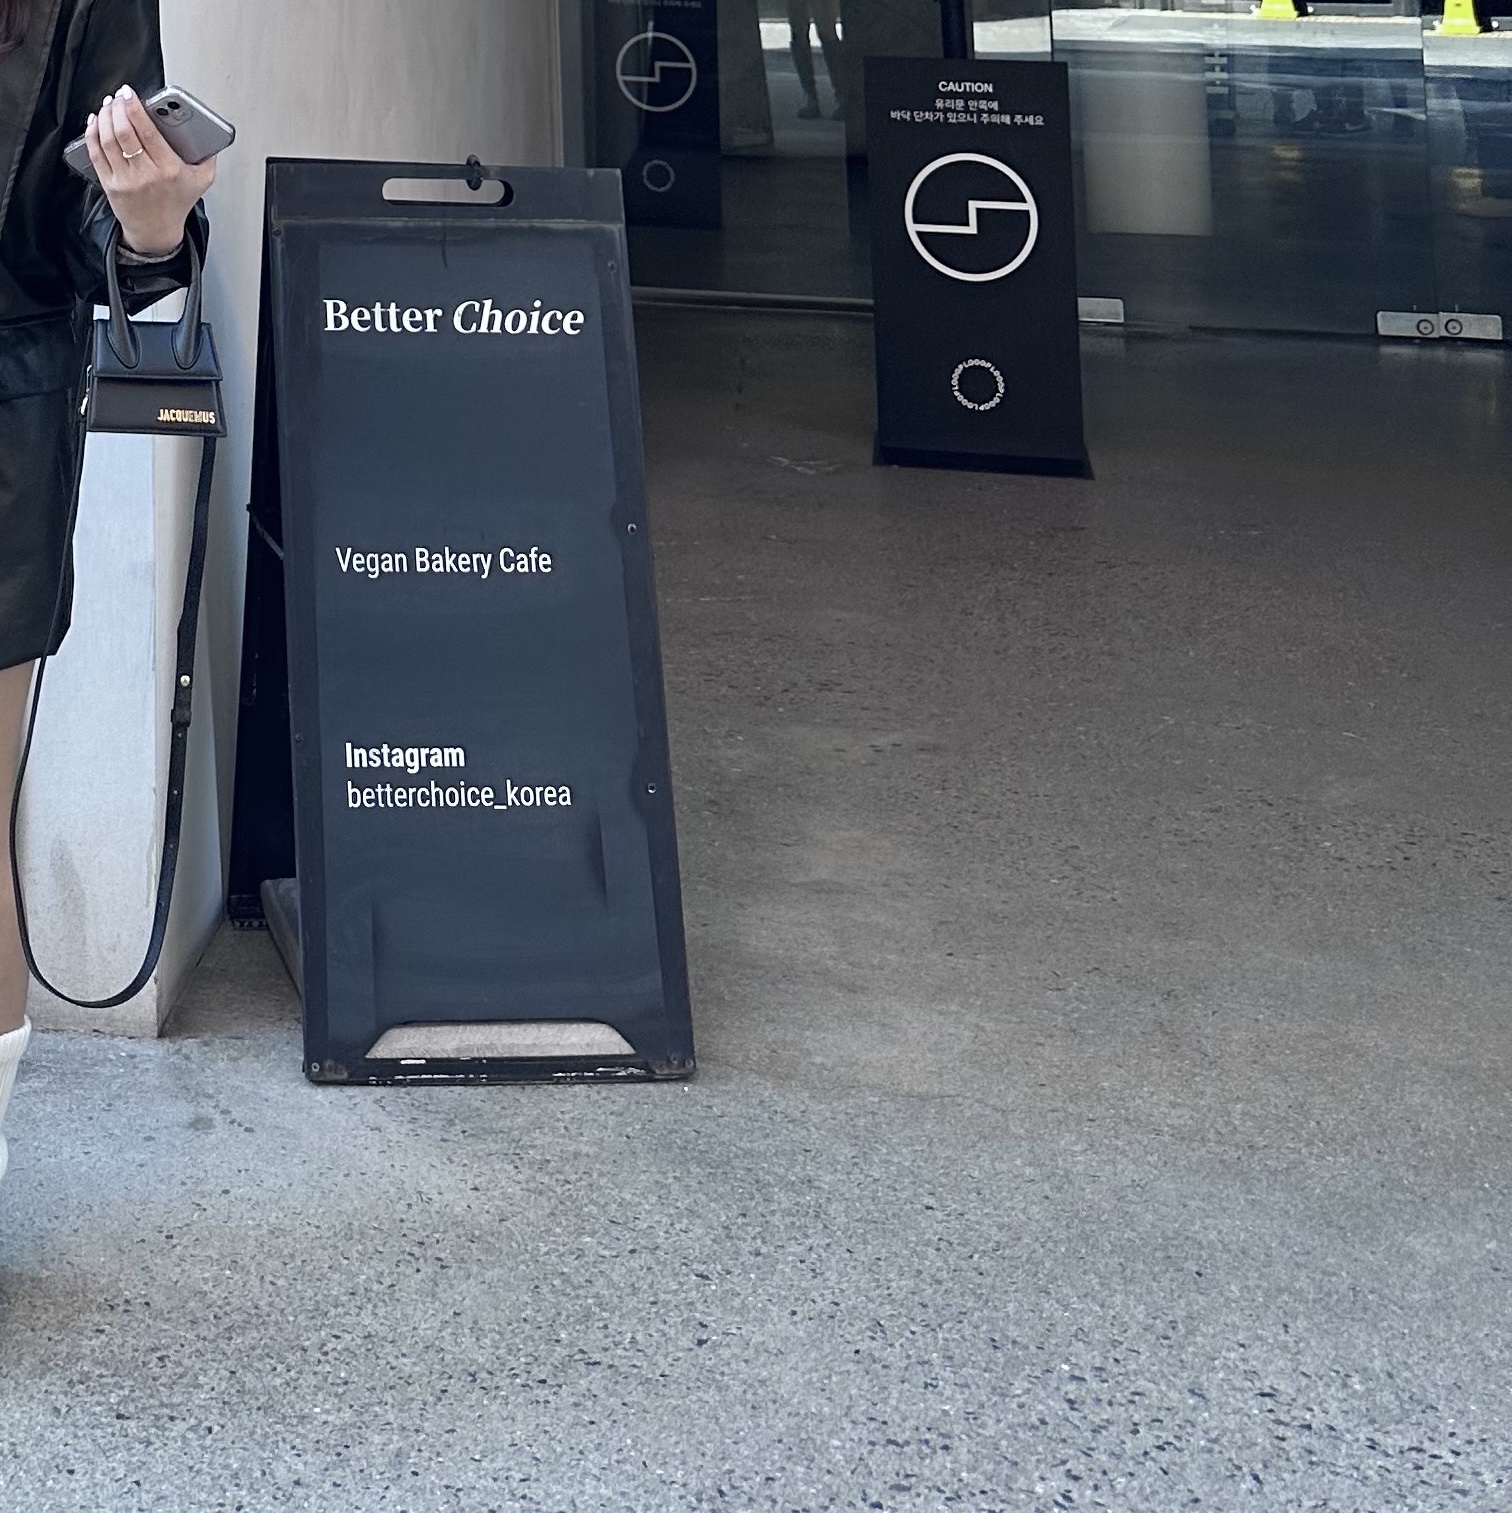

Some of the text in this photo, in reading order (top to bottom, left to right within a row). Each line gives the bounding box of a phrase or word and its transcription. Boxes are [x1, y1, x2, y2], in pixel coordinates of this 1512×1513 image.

[938, 81, 994, 93] CAUTION
[934, 99, 999, 111] 유리문 안쪽에
[890, 110, 1045, 126] 바닥 단차가 있으니 주의해 주세요
[322, 298, 585, 335] Better Choice
[157, 408, 216, 425] JACQUEMUS
[335, 546, 552, 579] Vegan Bakery Cafe
[345, 742, 465, 774] Instagram
[347, 779, 572, 810] betterchoice_korea
